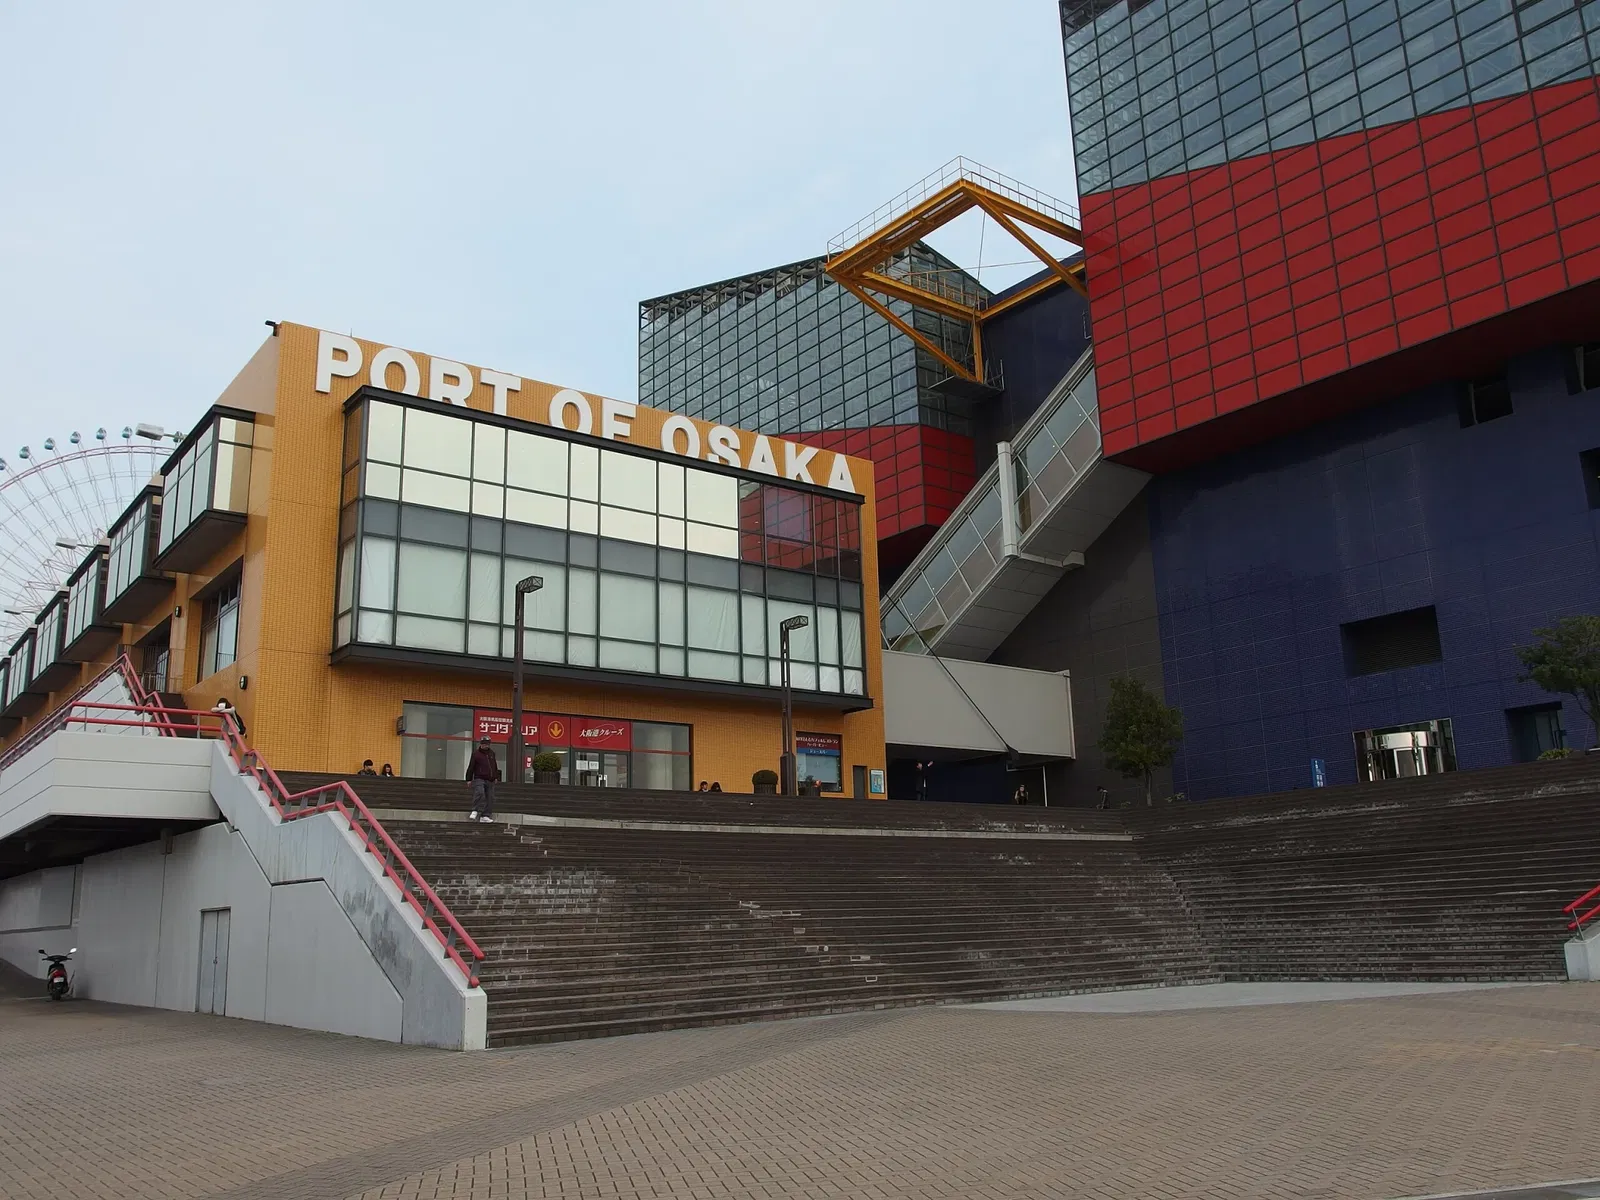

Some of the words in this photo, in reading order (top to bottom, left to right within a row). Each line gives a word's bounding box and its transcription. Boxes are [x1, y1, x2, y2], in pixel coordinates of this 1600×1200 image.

[315, 330, 522, 417] PORT
[548, 388, 637, 442] OF
[660, 415, 857, 494] OSAKA
[479, 722, 538, 736] サンタリア
[579, 727, 625, 738] 大阪港クルーズ
